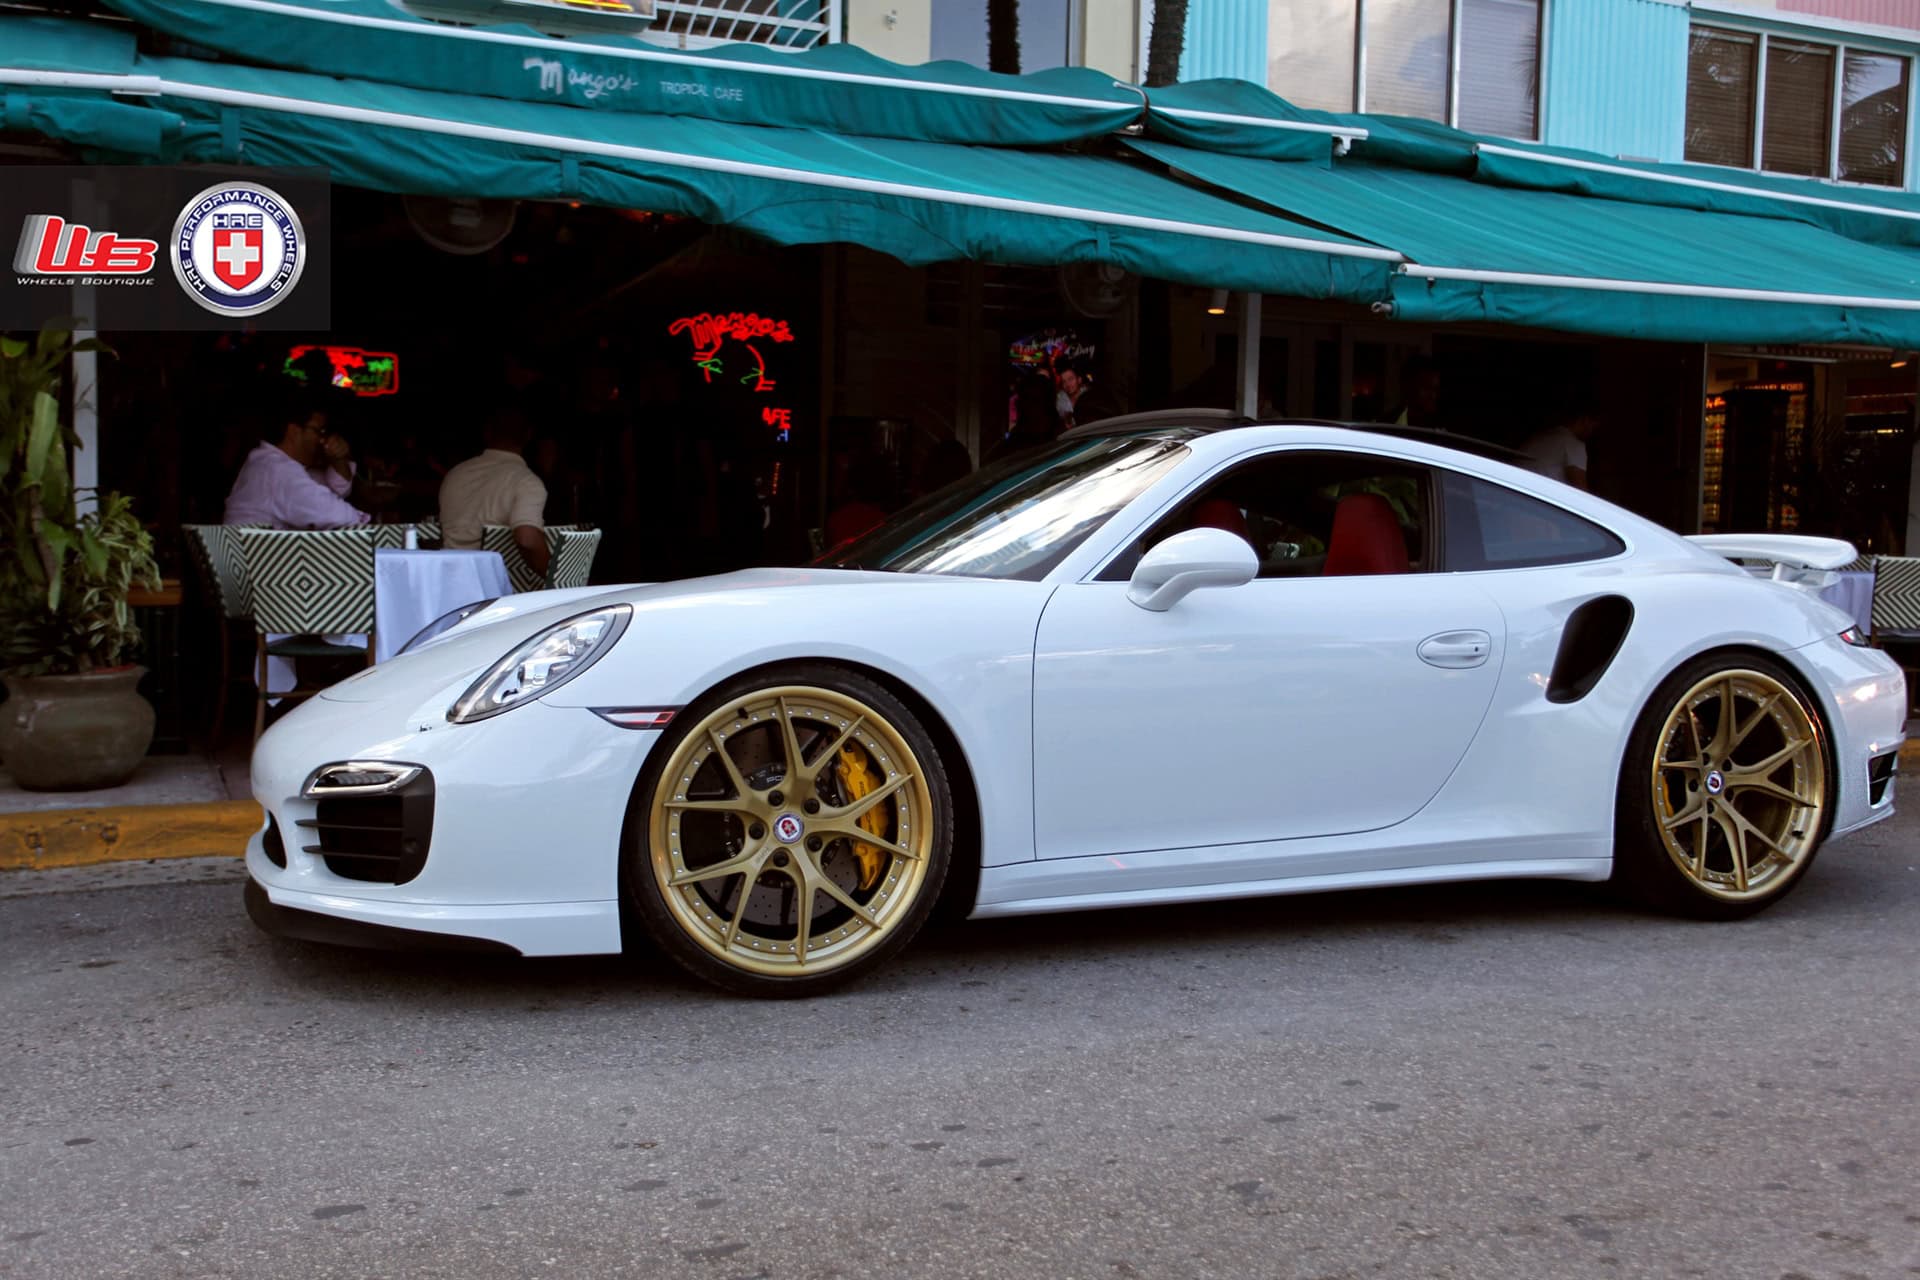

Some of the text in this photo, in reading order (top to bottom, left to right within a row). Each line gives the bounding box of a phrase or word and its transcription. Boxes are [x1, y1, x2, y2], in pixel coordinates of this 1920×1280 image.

[523, 58, 744, 101] Mango's TROPICAL CAFE
